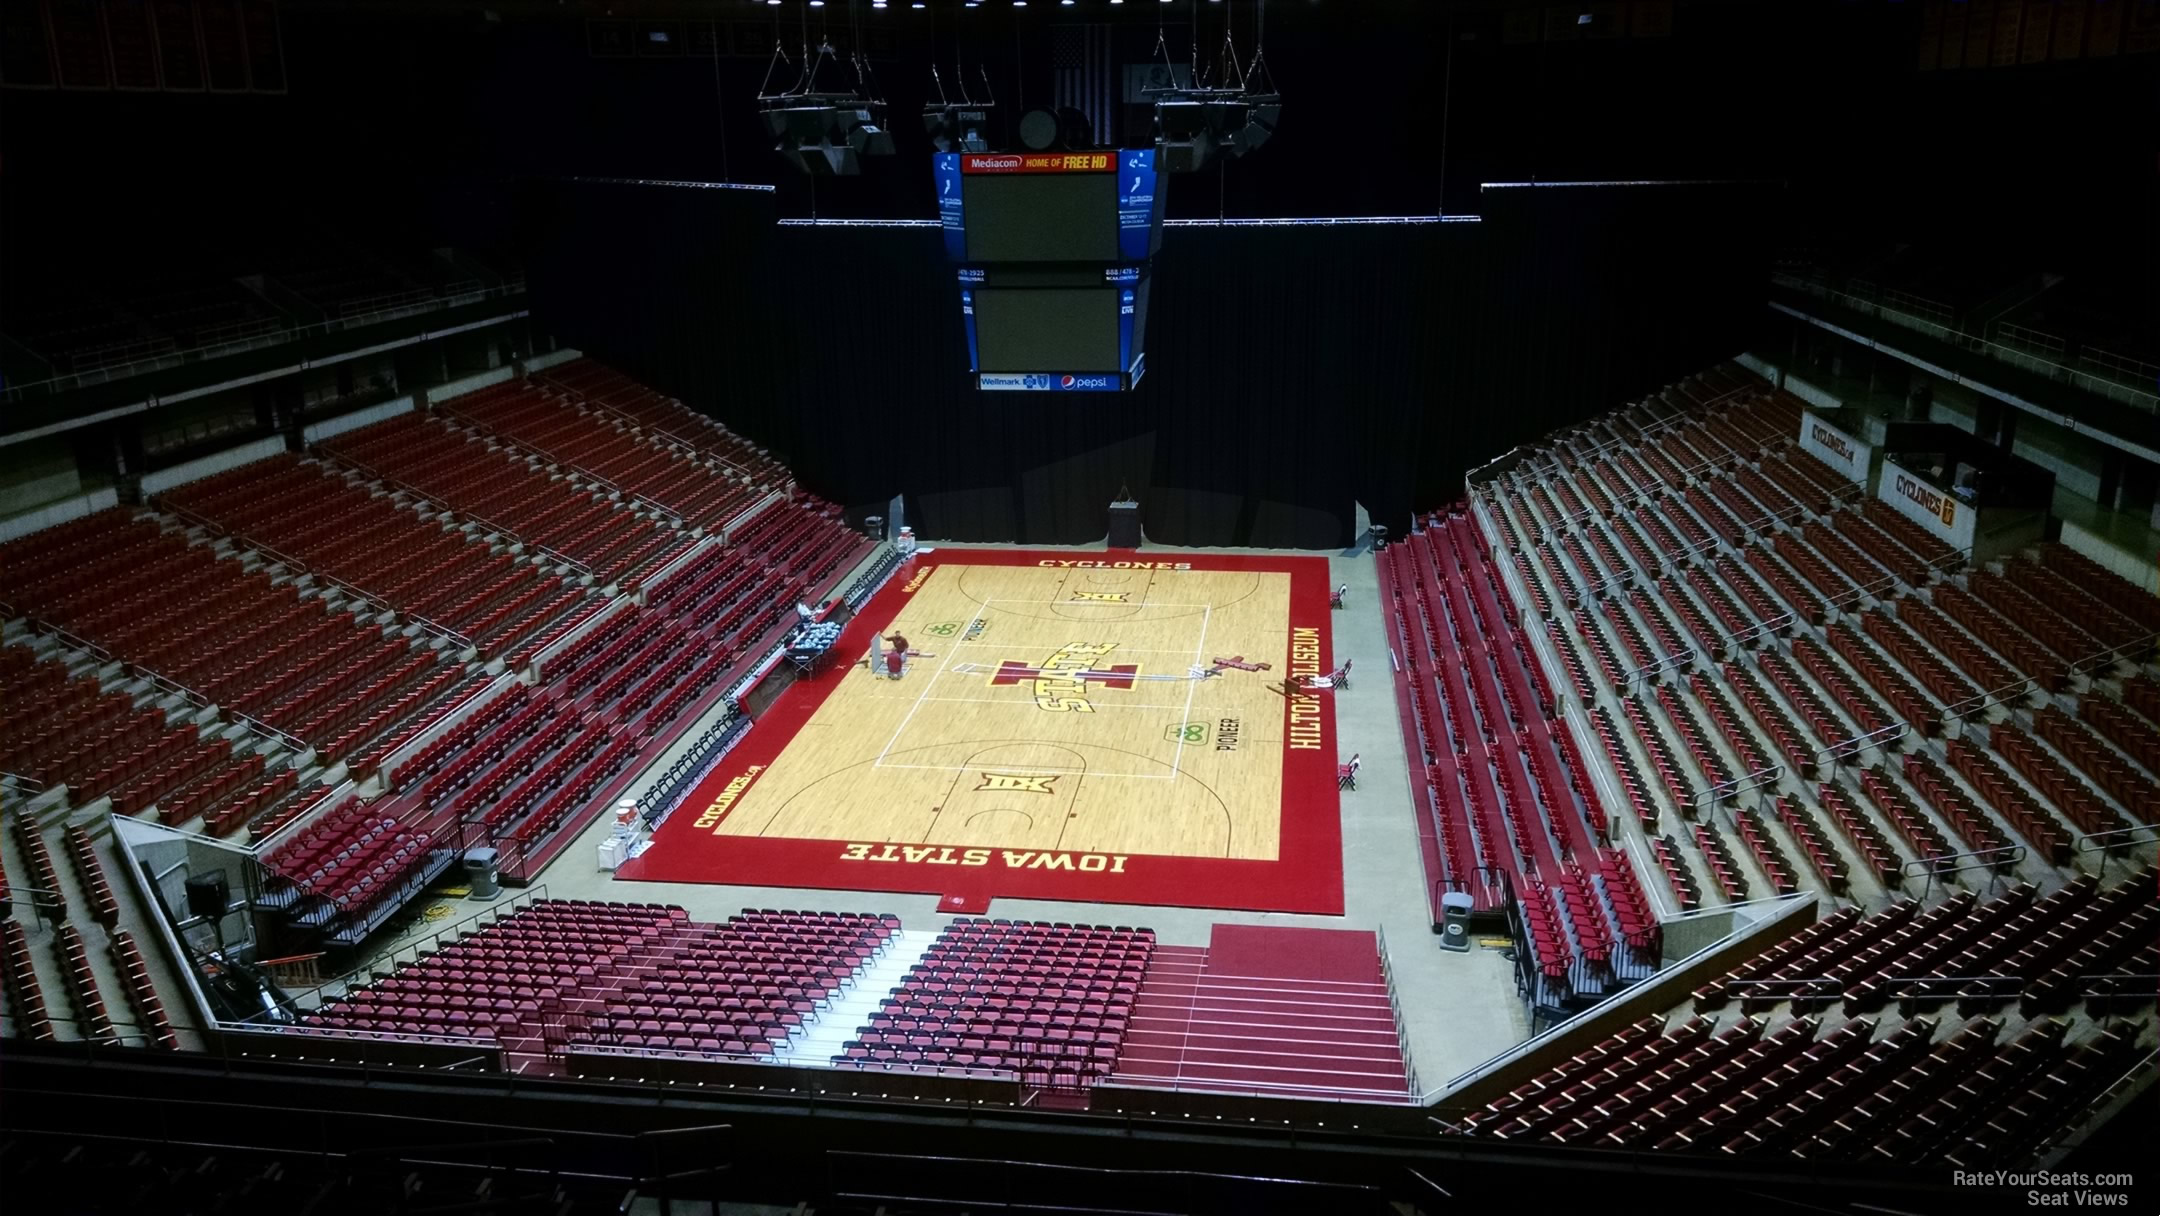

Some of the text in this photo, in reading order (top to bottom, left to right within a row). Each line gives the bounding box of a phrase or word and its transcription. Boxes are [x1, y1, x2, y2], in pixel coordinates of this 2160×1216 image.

[971, 158, 1018, 168] Mediacom
[1026, 155, 1107, 169] HOME OF FREE HD
[981, 377, 1020, 386] Wellmark
[1077, 377, 1107, 388] pepsi
[1896, 474, 1941, 516] CYCLONES
[1038, 560, 1192, 570] CYCLONES
[1290, 694, 1321, 750] HILTON
[1216, 718, 1240, 751] PIONEER
[840, 843, 1129, 873] IOWA STATE
